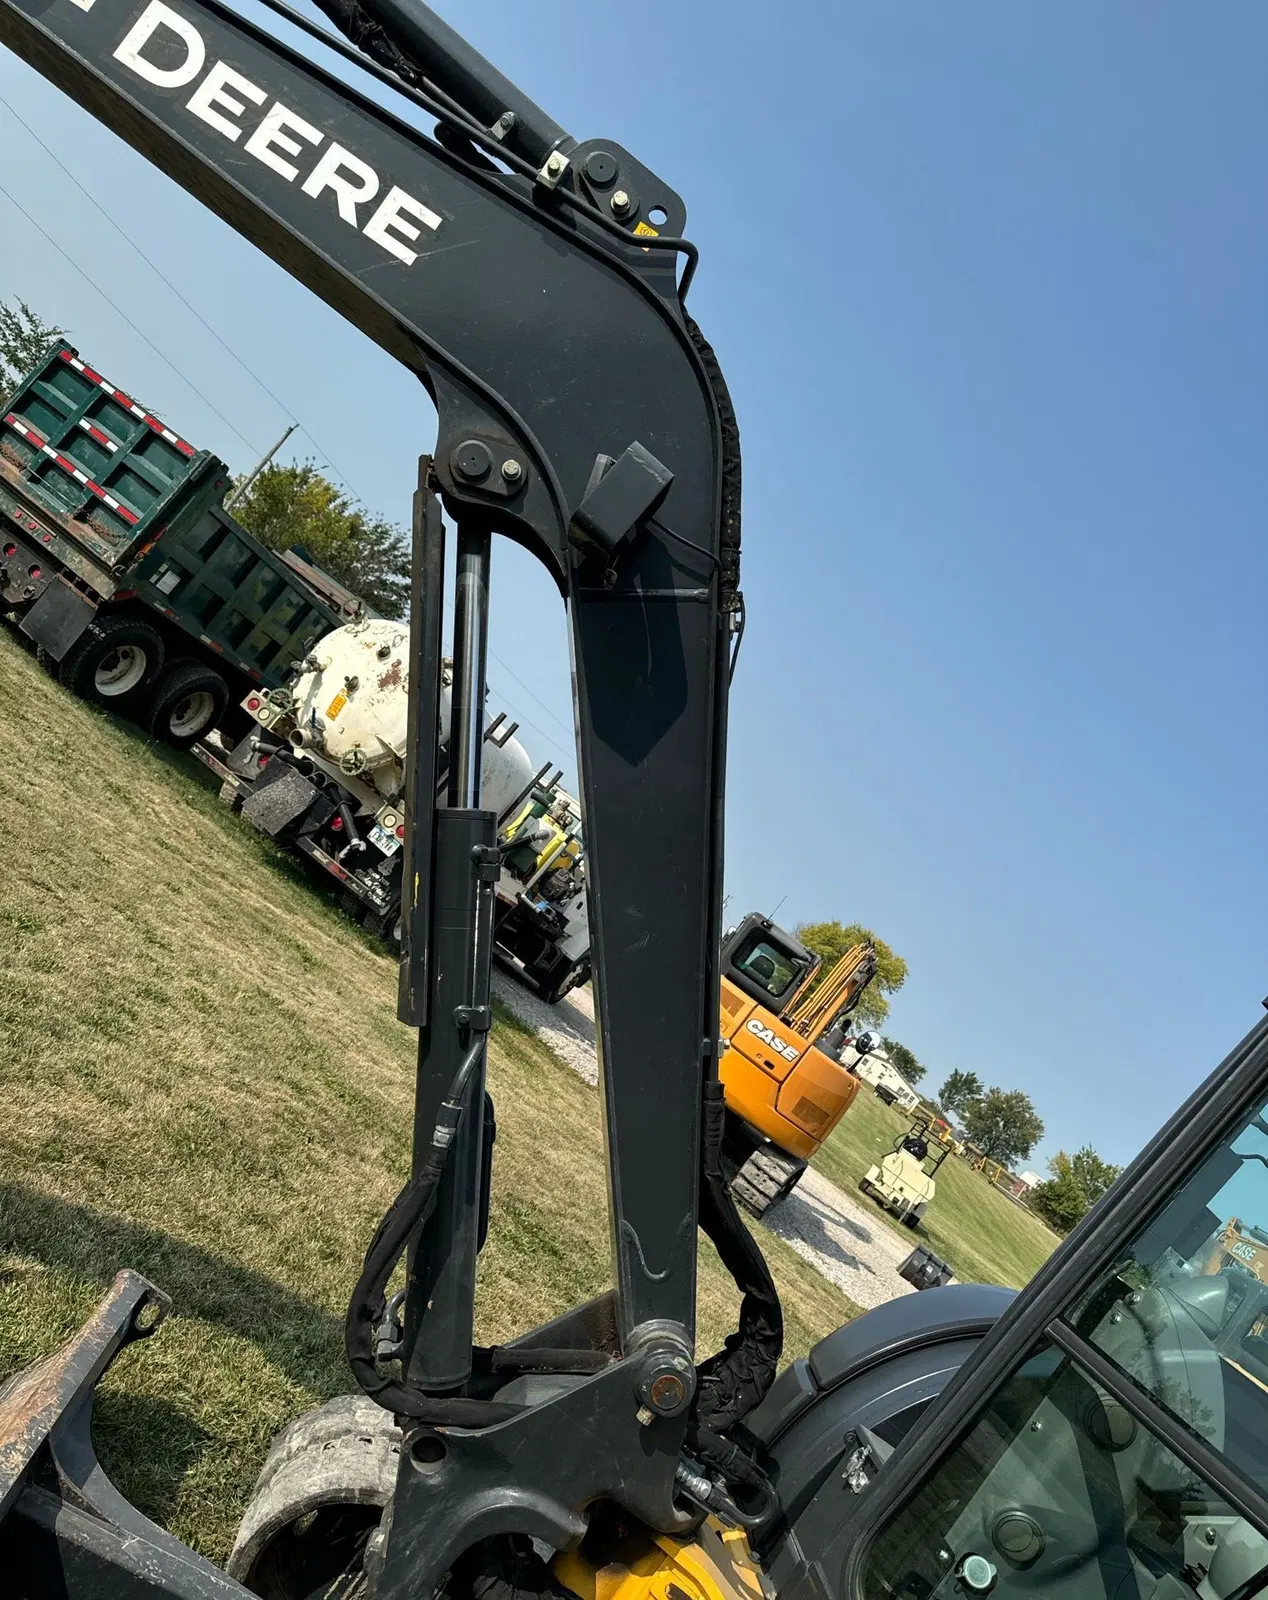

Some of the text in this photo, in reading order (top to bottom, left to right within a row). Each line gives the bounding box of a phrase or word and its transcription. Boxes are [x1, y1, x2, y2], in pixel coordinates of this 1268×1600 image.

[112, 0, 443, 266] DEERE
[746, 1019, 801, 1062] CASE
[1231, 1242, 1257, 1261] CASE
